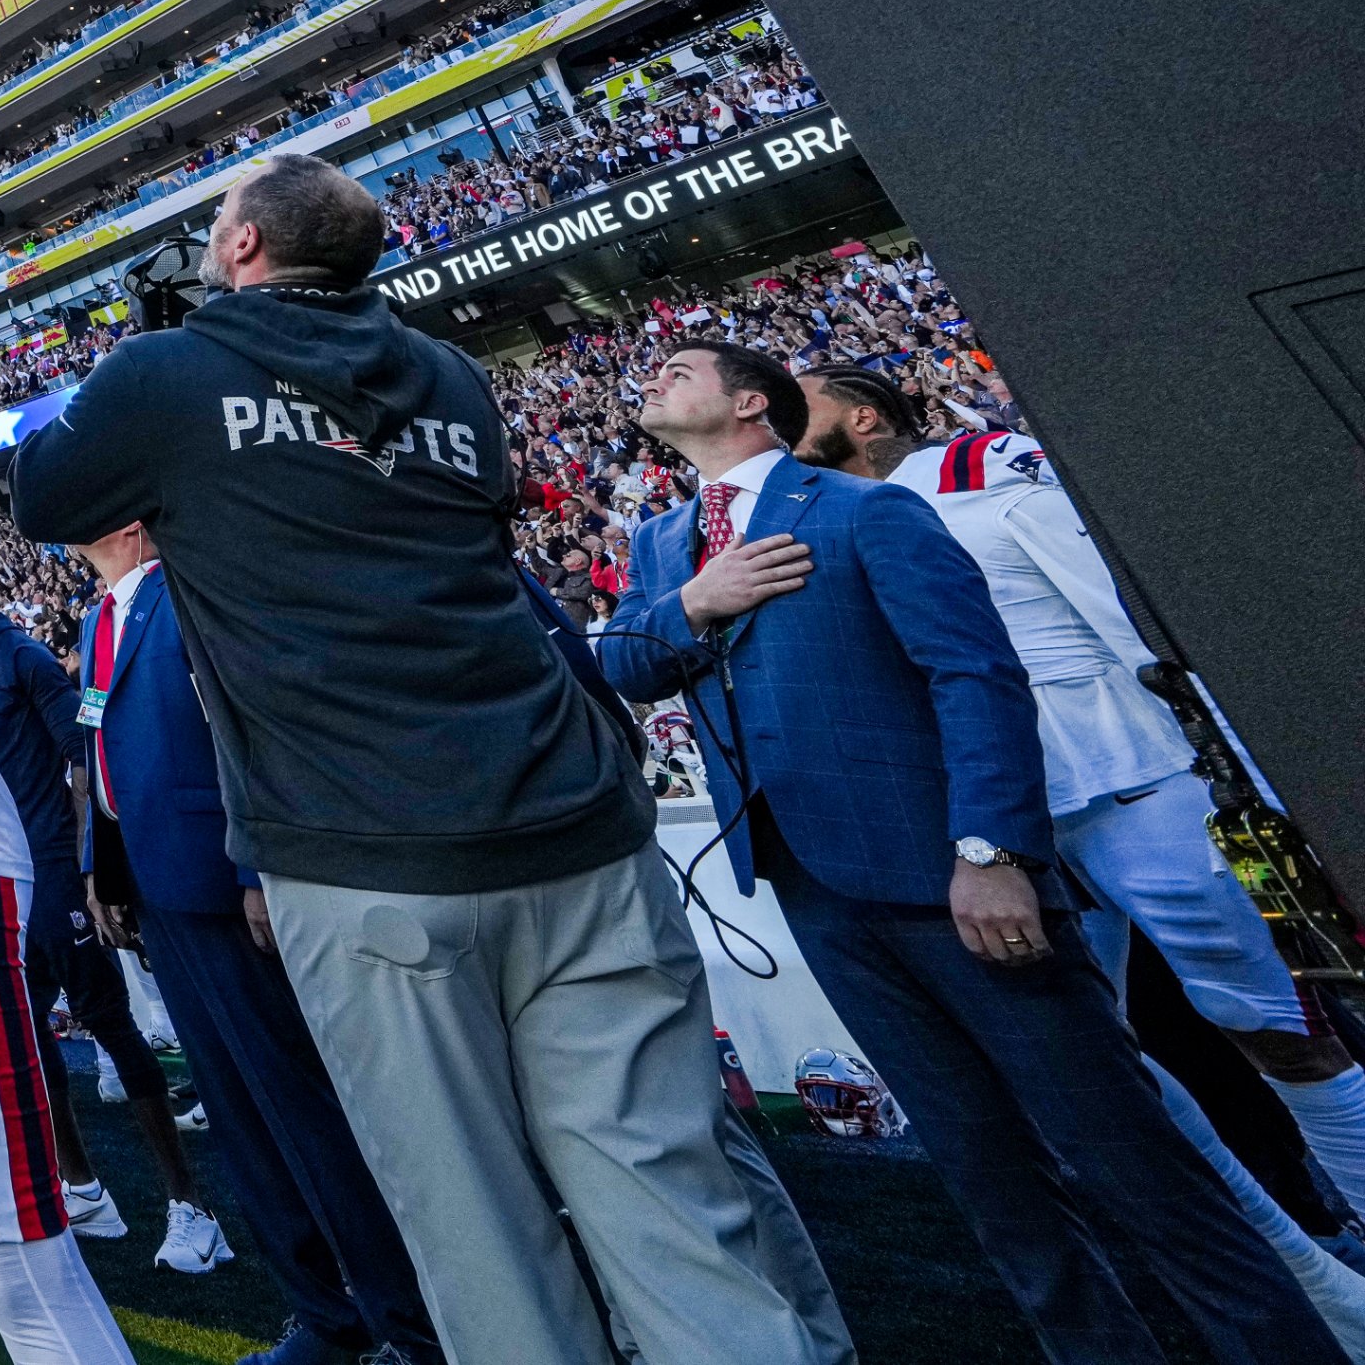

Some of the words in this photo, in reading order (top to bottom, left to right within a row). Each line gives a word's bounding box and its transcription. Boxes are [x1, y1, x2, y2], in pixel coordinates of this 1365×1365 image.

[377, 267, 441, 304] AND
[441, 242, 512, 285] THE
[511, 202, 622, 263] HOME
[624, 180, 674, 221] OF
[678, 149, 766, 200] THE
[275, 379, 302, 396] NE
[222, 396, 478, 477] PATTS
